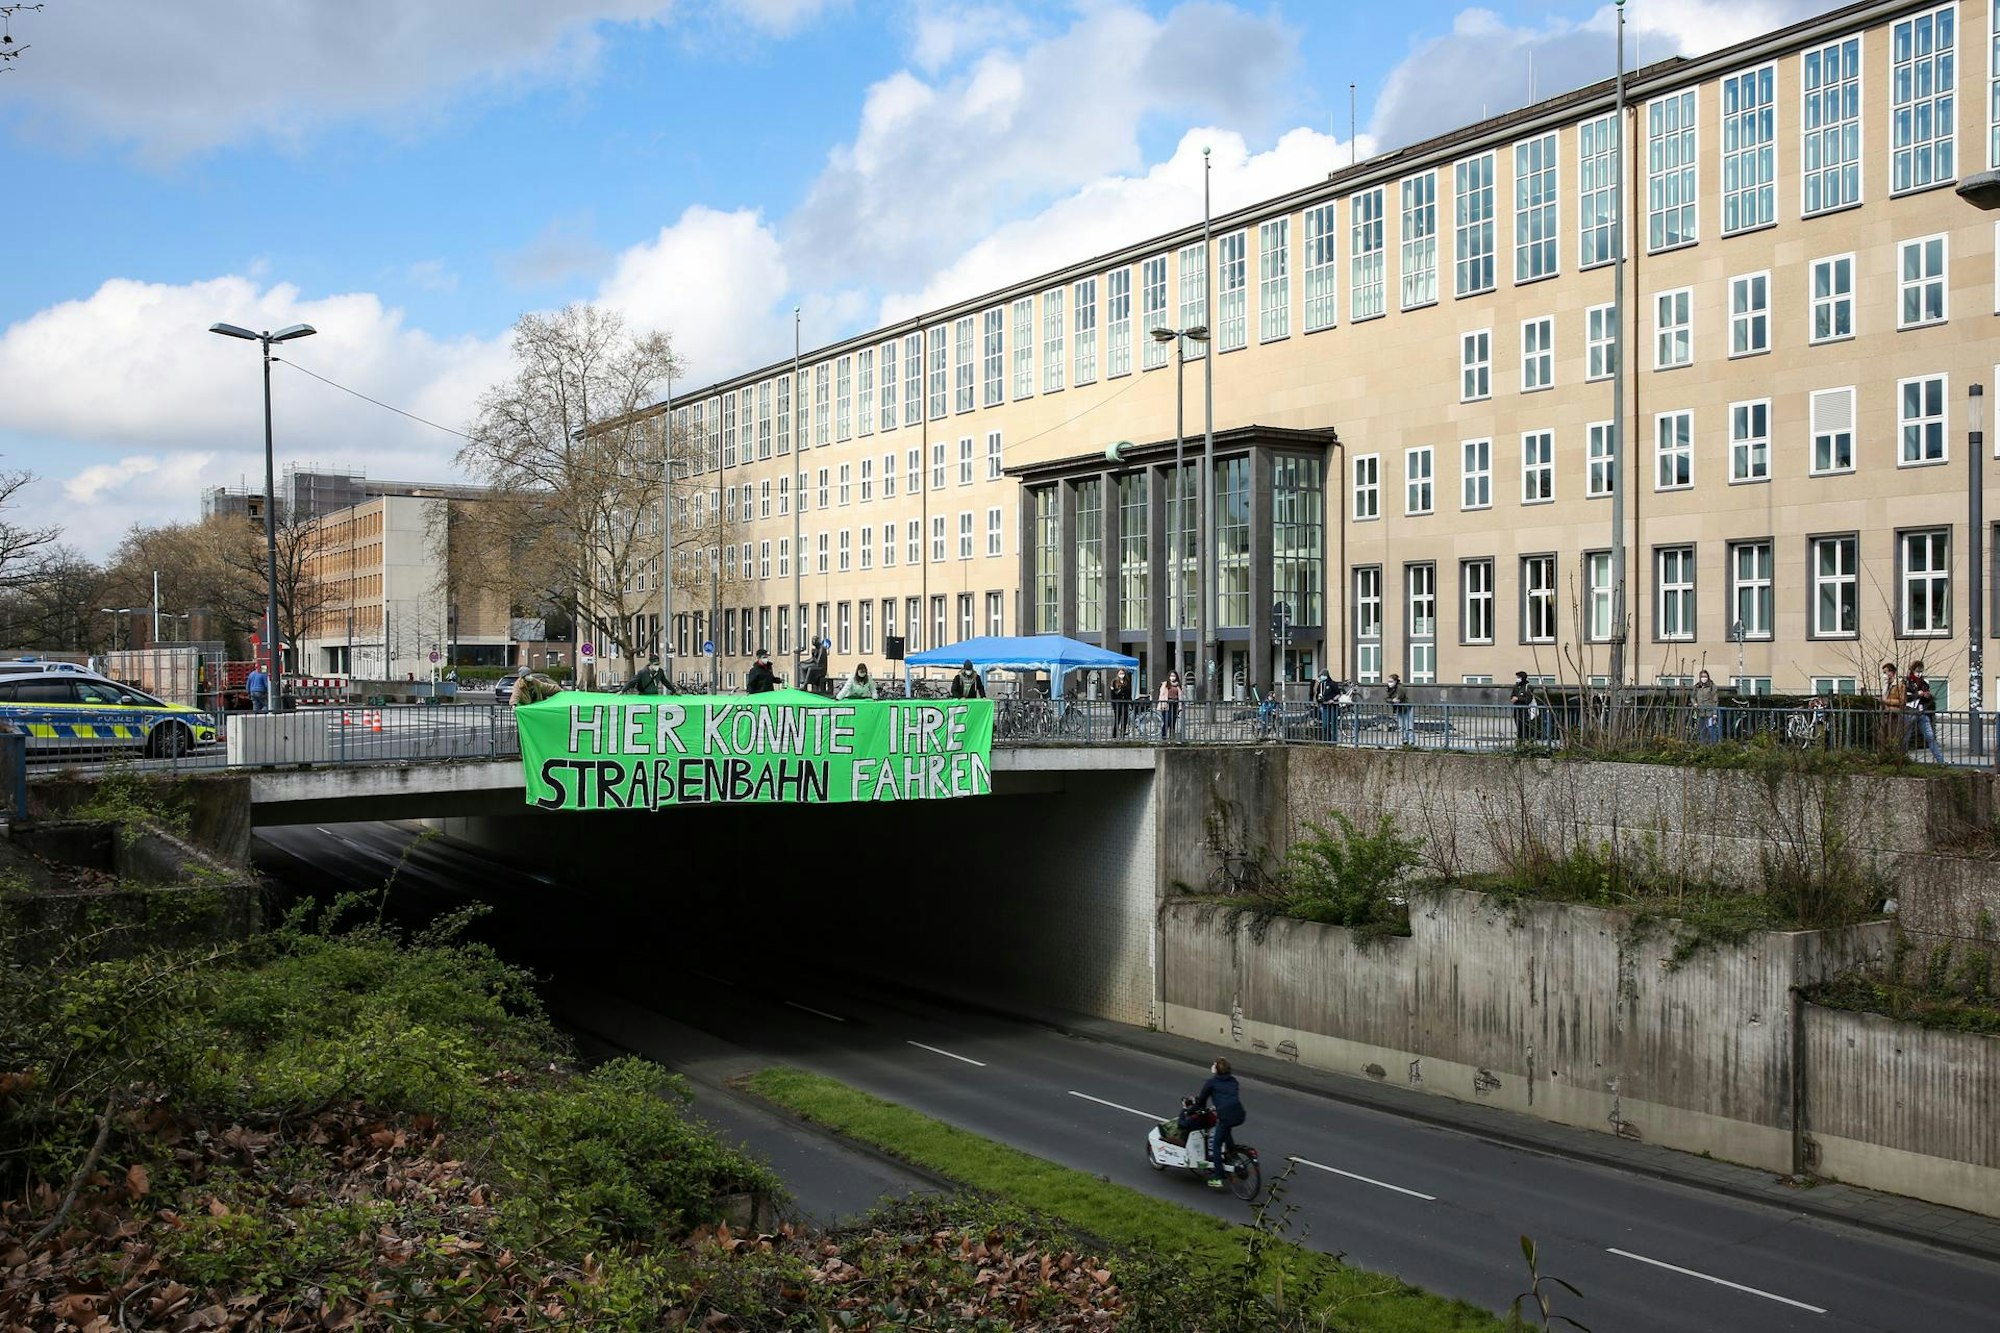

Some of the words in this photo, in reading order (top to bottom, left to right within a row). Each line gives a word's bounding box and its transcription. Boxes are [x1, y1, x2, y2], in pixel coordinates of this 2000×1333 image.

[568, 704, 687, 754] HIER
[703, 703, 855, 755] KÖNNTE
[889, 704, 968, 754] IHRE
[851, 751, 992, 801] FAHREN
